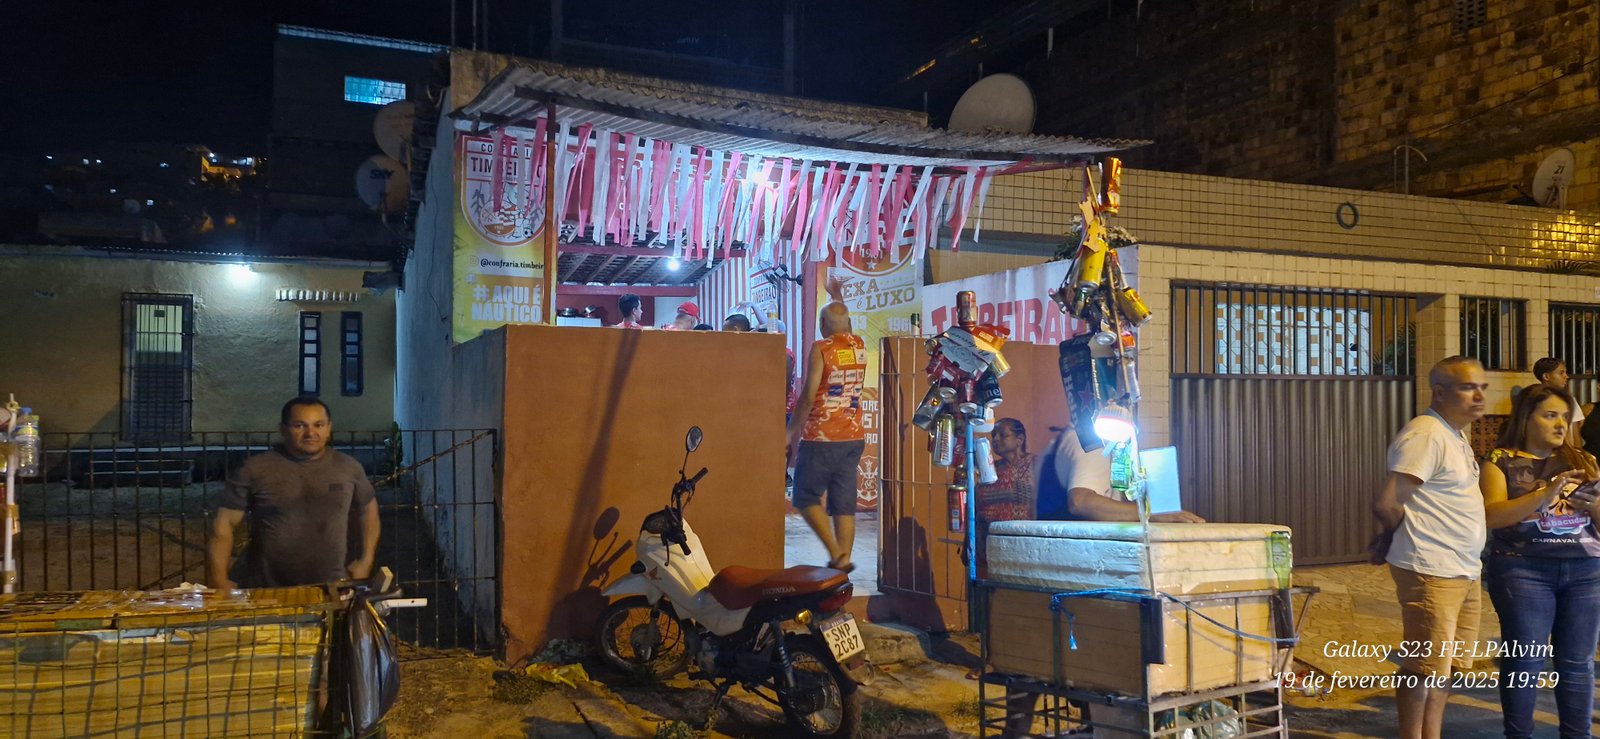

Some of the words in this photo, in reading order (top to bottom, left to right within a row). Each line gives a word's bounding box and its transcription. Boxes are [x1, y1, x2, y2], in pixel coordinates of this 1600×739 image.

[370, 169, 395, 179] SKY
[480, 257, 544, 270] @confraria.timbeir
[533, 284, 541, 304] É
[843, 278, 880, 299] EXA
[865, 286, 916, 311] LUXO
[471, 301, 541, 323] NÁUTICO
[763, 586, 796, 595] HONDA
[831, 623, 851, 641] SNP
[834, 634, 859, 657] 2C87
